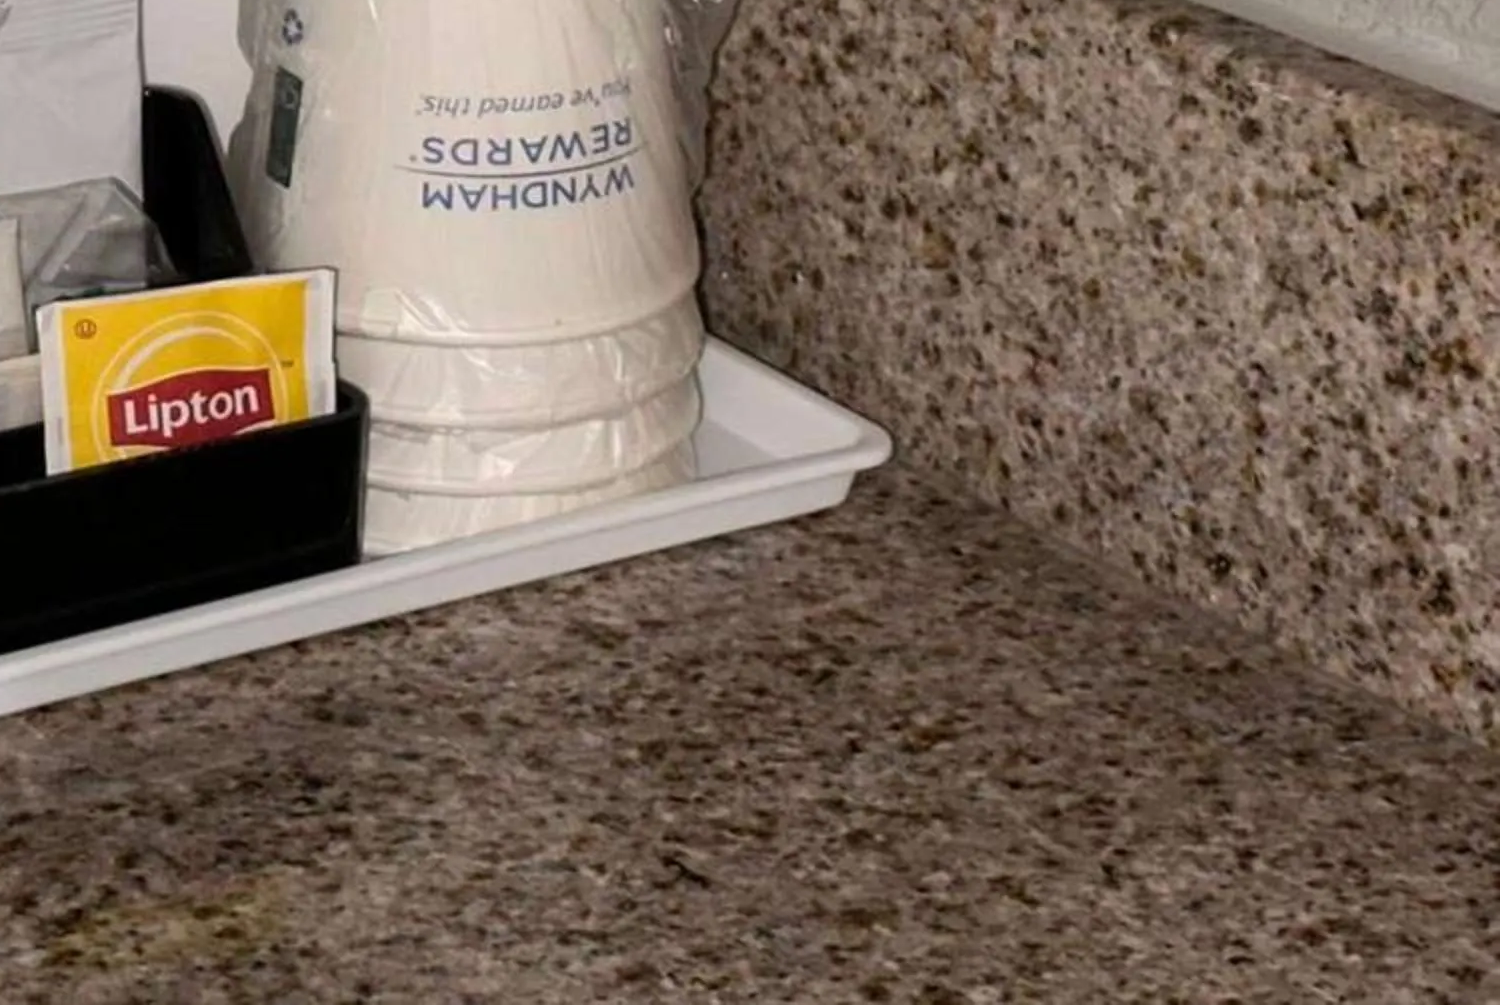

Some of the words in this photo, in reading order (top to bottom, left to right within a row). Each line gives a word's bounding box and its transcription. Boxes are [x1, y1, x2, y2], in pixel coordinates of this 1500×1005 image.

[477, 92, 564, 118] earned
[422, 163, 634, 211] WYNDHAM
[123, 384, 260, 438] Lipton
